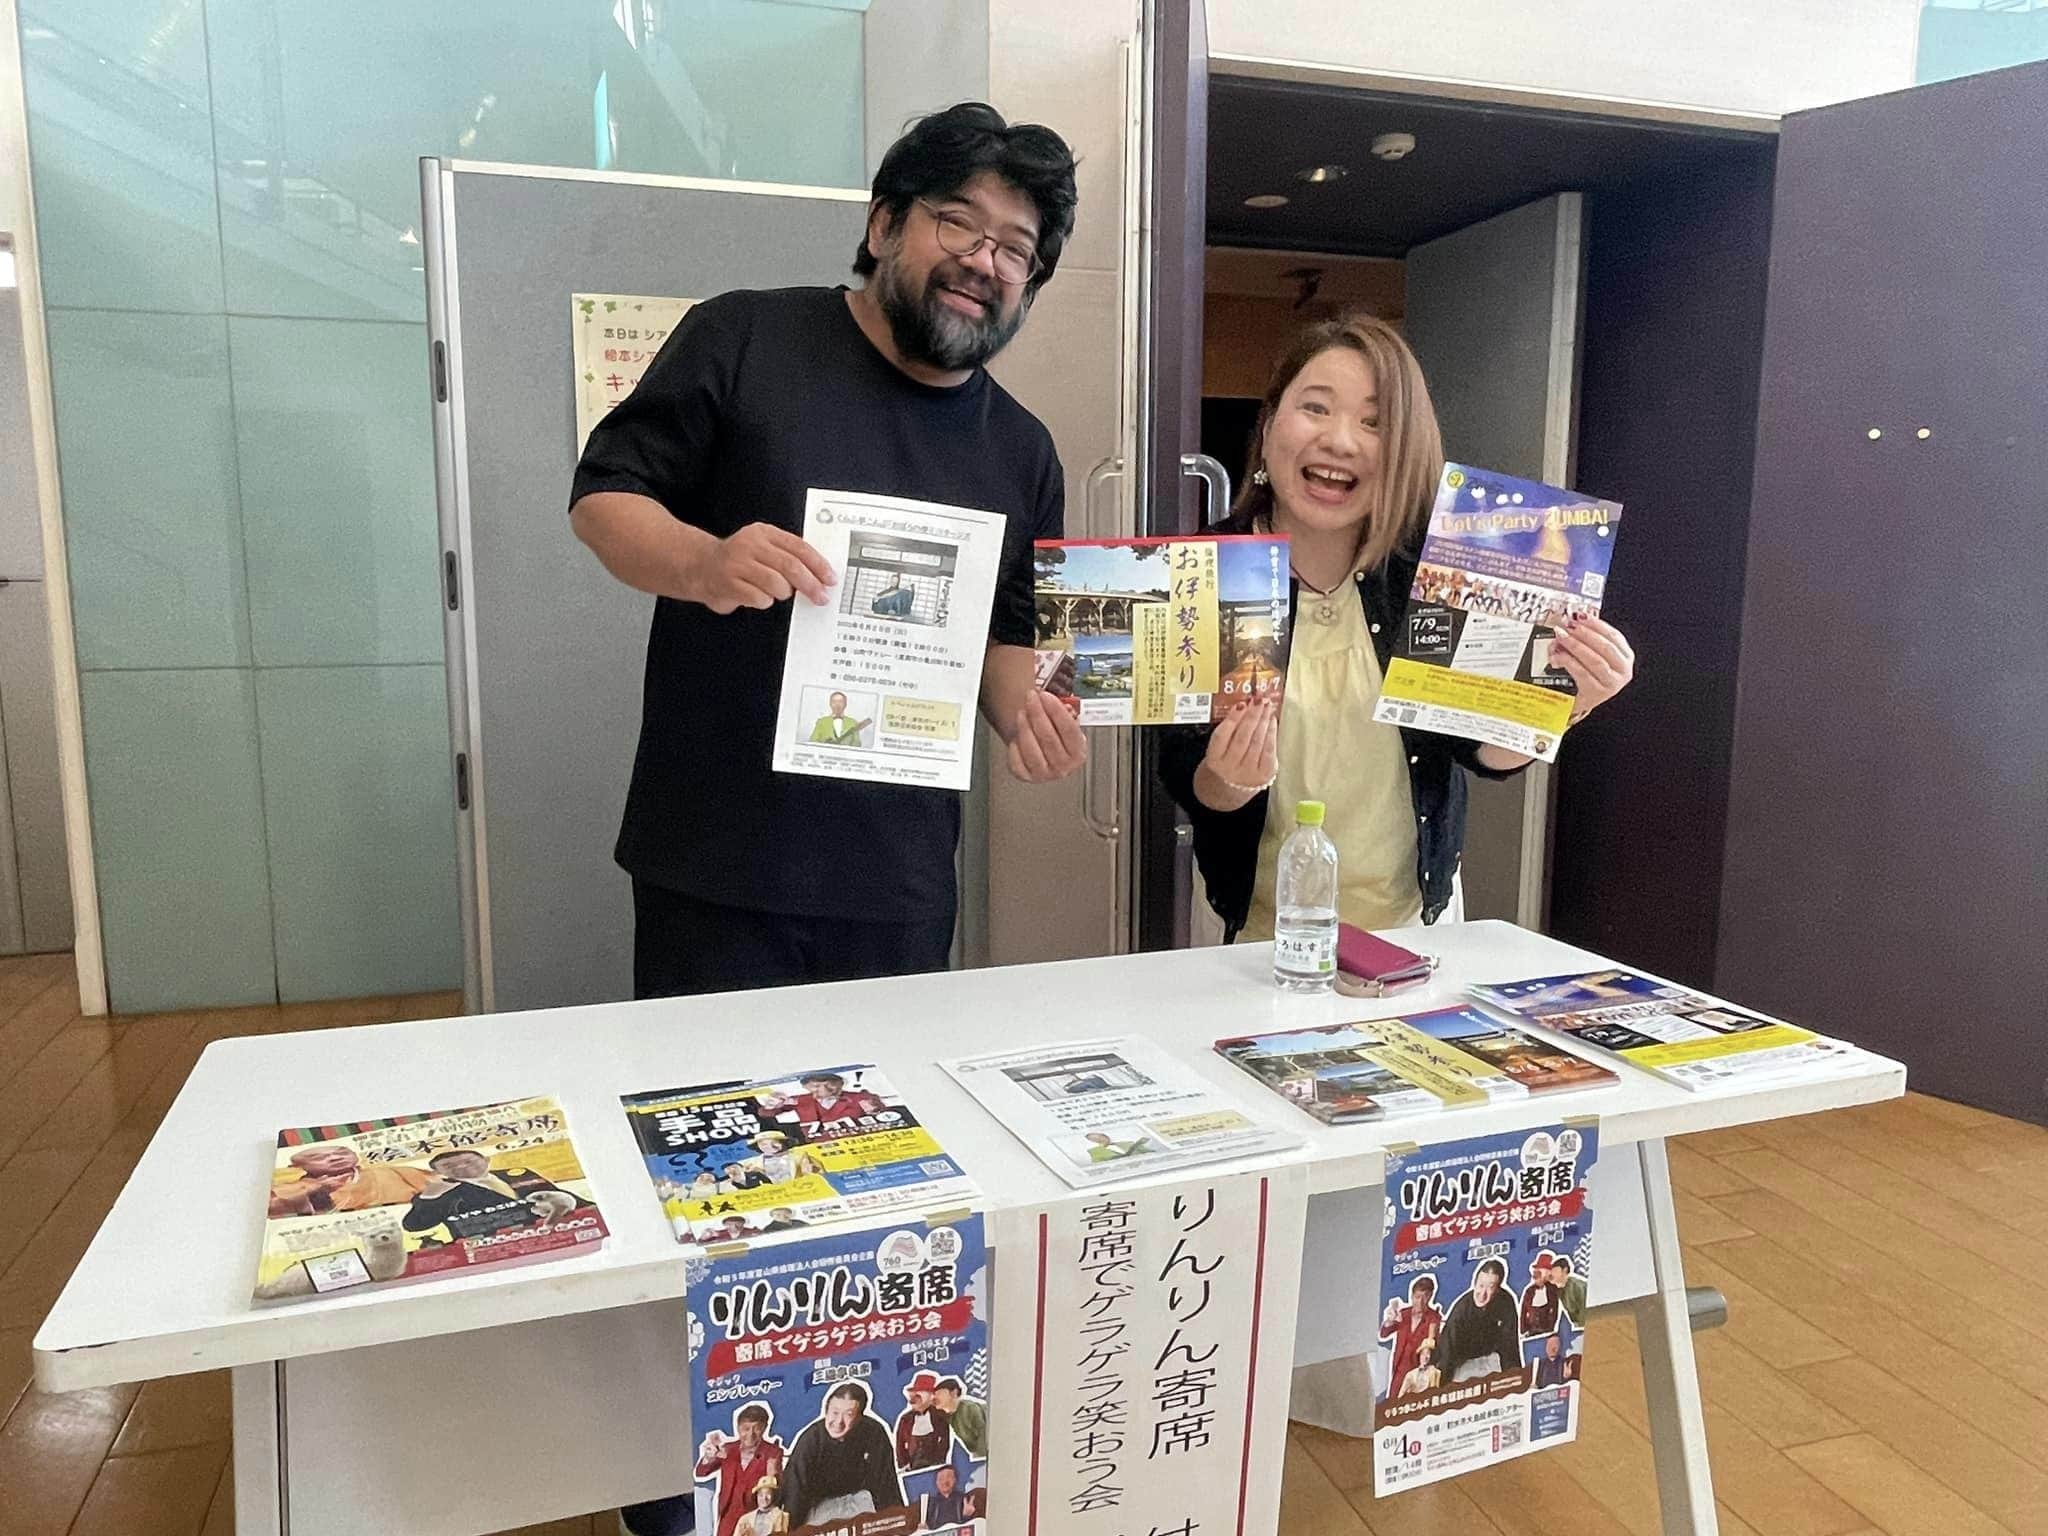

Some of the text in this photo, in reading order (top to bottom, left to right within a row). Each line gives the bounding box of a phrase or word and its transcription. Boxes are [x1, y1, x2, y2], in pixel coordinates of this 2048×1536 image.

[603, 327, 639, 341] 本日は
[1491, 513, 1538, 531] Party
[1174, 544, 1200, 690] お伊勢参り
[1412, 617, 1437, 631] 7/9
[658, 1107, 758, 1135] 手品
[667, 1123, 761, 1147] SHOW
[495, 1136, 545, 1151] 6.24
[1401, 1161, 1575, 1221] りんりん寄席
[1415, 1199, 1562, 1242] 寄席でゲラゲラ笑おう会
[710, 1266, 957, 1338] りんりん寄席
[734, 1311, 942, 1364] 寄席でゲラゲラ笑おう会
[1147, 1187, 1225, 1461] りんりん寄席
[1069, 1196, 1138, 1515] 寄席でゲラゲラ笑おう会
[706, 1373, 742, 1388] マジック
[706, 1380, 783, 1403] コンプレッサー
